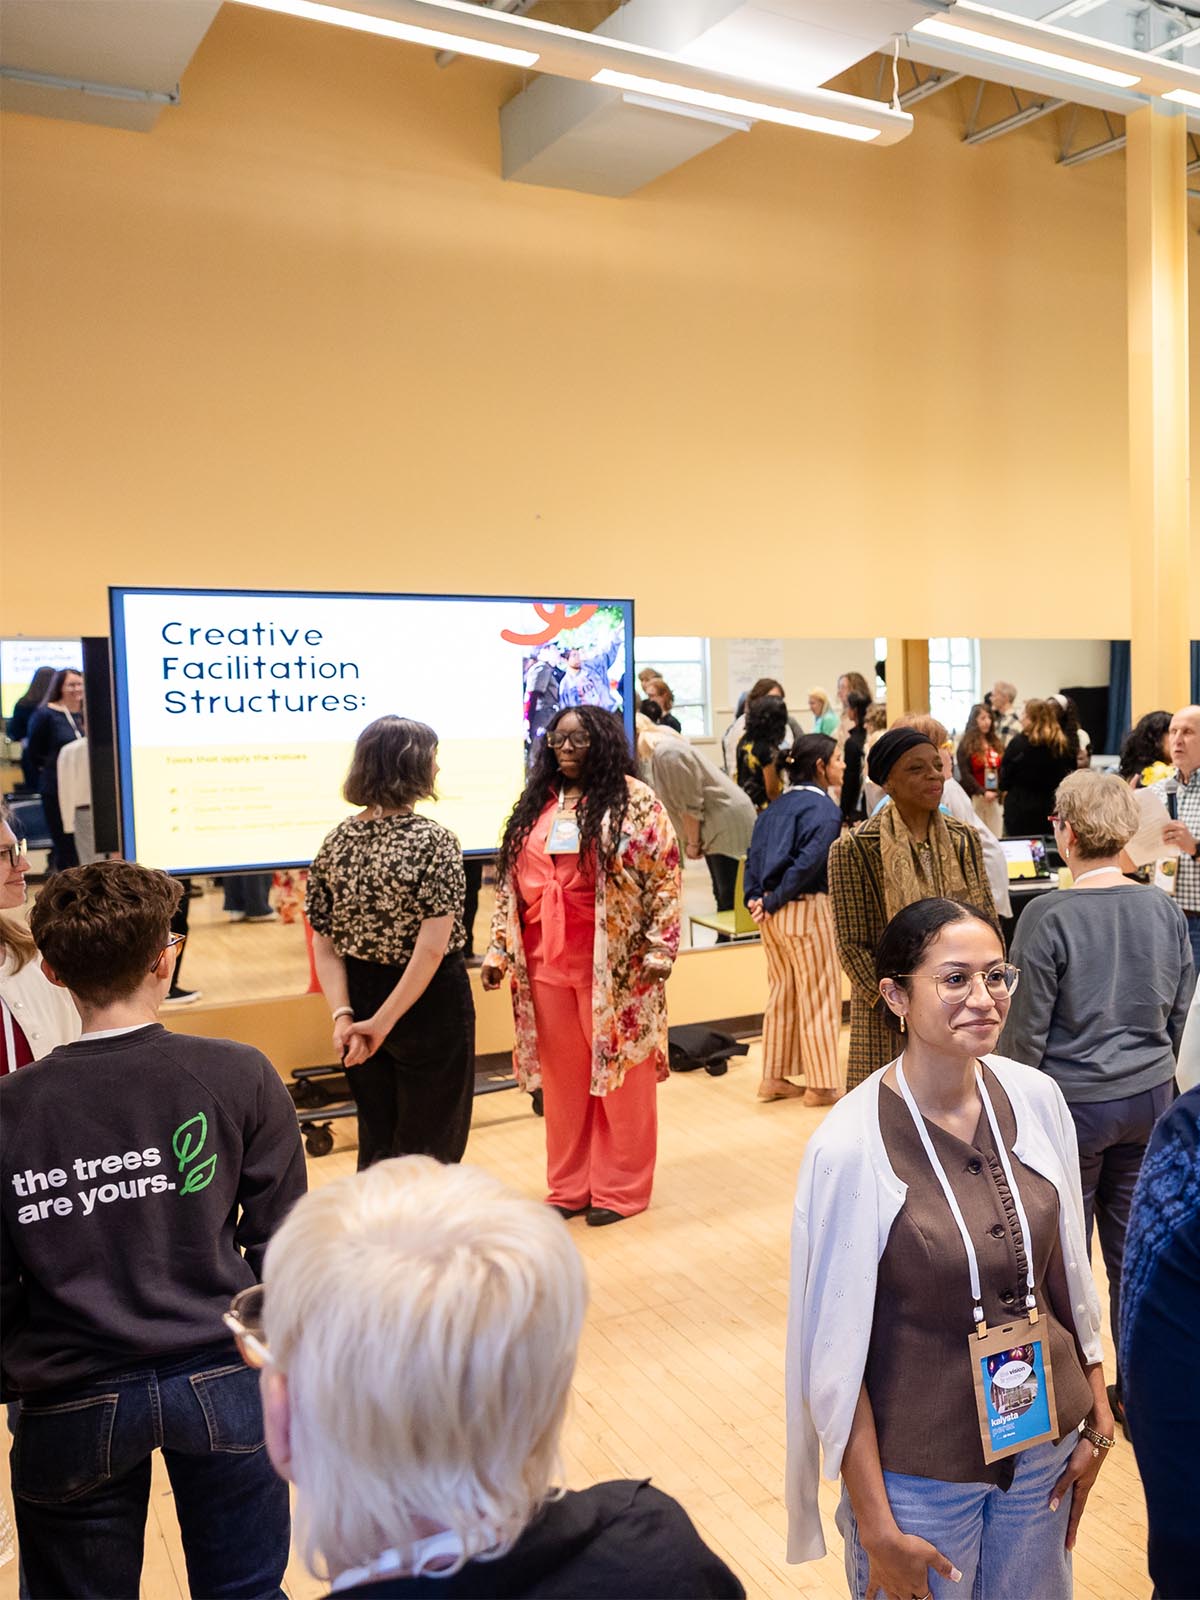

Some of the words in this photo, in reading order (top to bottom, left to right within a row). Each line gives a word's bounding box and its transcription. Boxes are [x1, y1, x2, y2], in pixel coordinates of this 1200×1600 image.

[162, 622, 323, 646] Creative
[163, 656, 359, 680] Facilitation
[165, 689, 366, 714] Structures:
[12, 1168, 68, 1197] the
[72, 1147, 162, 1181] trees
[18, 1196, 73, 1224] are
[78, 1174, 176, 1216] yours.
[1009, 1366, 1026, 1375] vision
